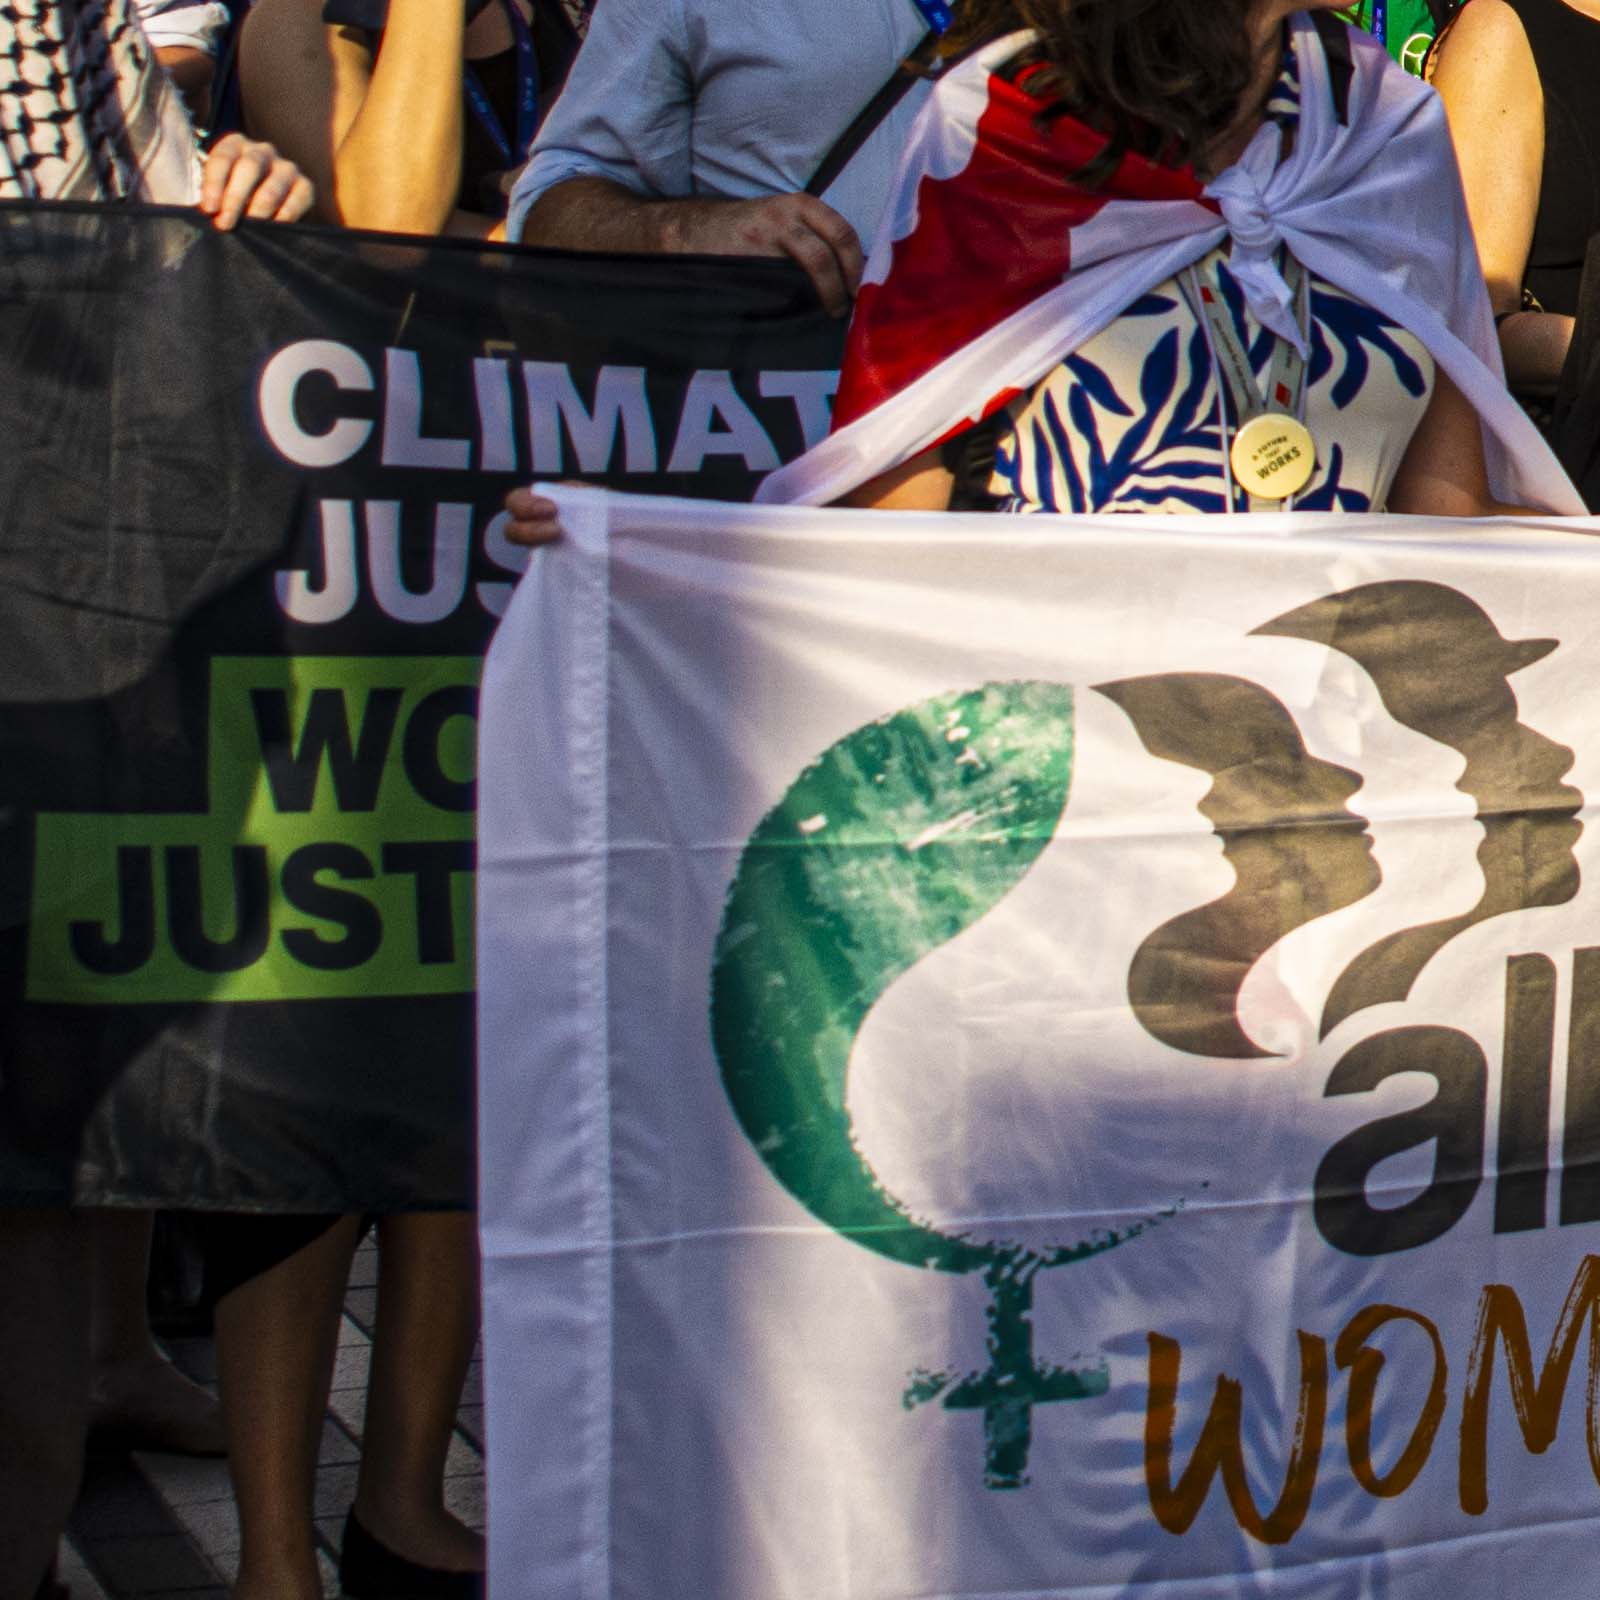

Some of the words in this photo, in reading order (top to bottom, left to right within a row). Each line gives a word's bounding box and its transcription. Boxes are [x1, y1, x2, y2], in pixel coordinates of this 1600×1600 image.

[256, 337, 841, 474] CLIMAT
[1256, 446, 1302, 480] WORKS
[67, 840, 477, 977] JUST
